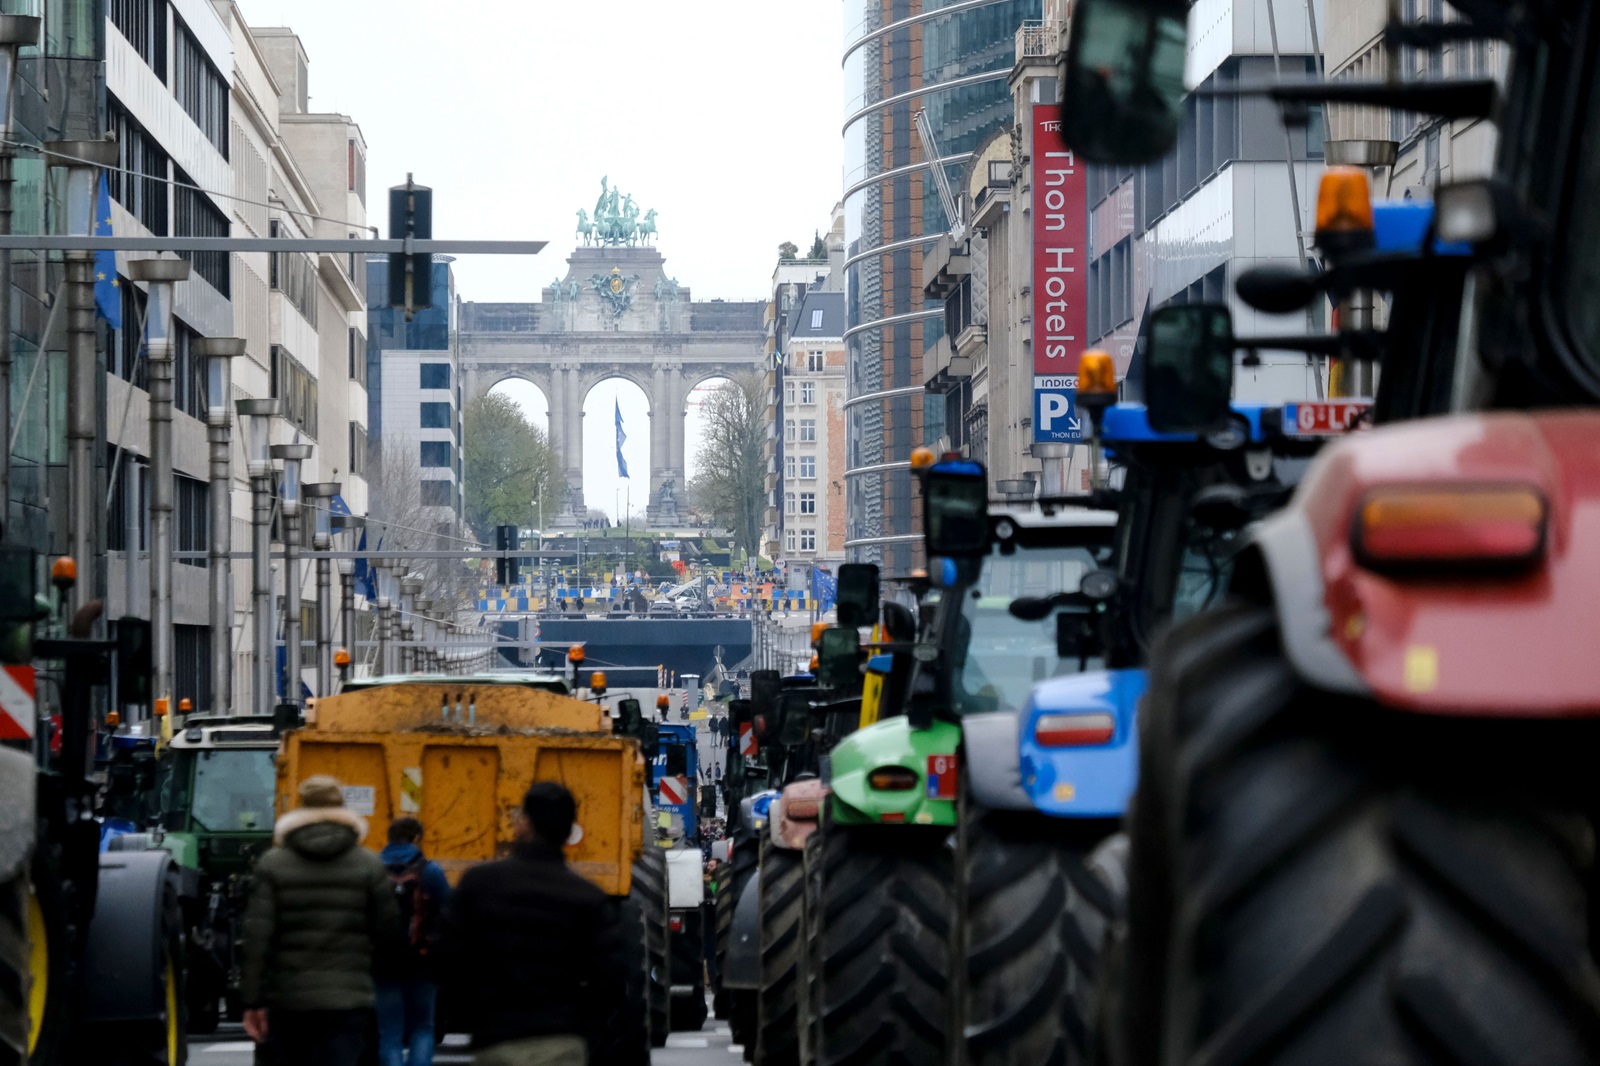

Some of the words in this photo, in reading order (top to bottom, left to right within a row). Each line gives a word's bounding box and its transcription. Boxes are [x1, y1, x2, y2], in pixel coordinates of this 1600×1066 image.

[1045, 149, 1074, 231] Thon
[1045, 247, 1075, 359] Hotels
[1040, 393, 1069, 431] P
